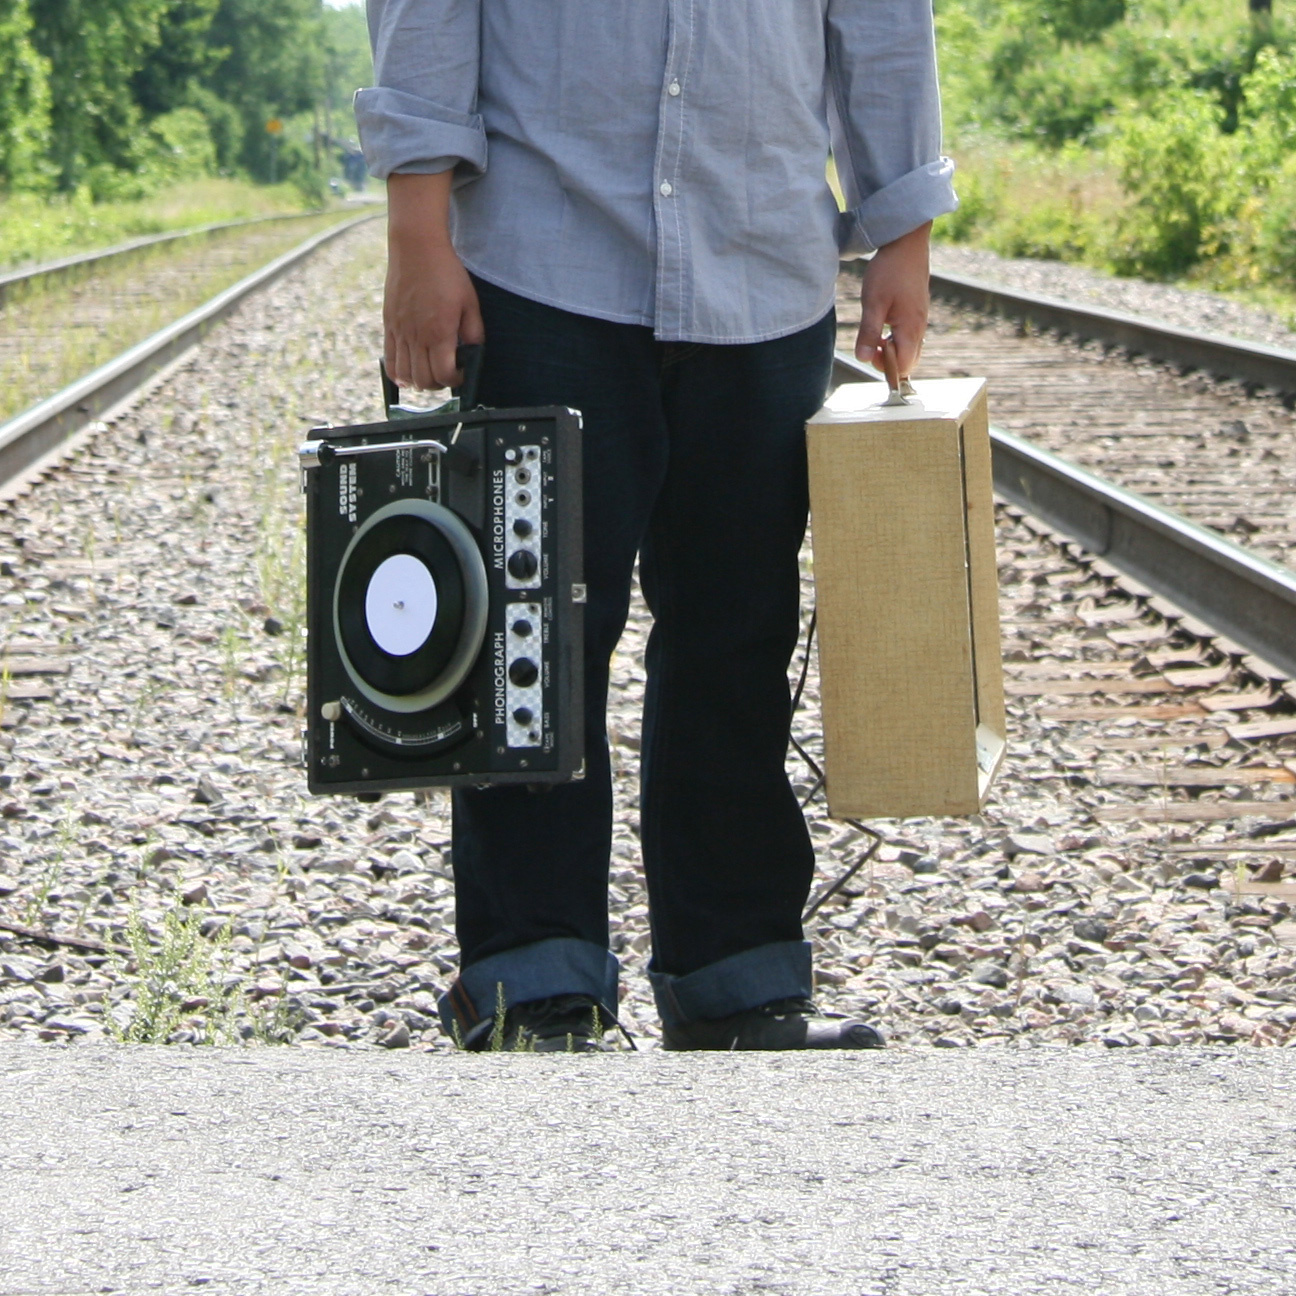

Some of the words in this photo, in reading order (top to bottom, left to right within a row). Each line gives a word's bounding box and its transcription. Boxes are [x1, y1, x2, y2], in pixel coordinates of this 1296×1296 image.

[339, 463, 348, 515] SOUND
[348, 462, 357, 522] SYSTEM
[493, 469, 504, 569] MICROPHONES
[494, 632, 505, 724] PHONOGRAPH
